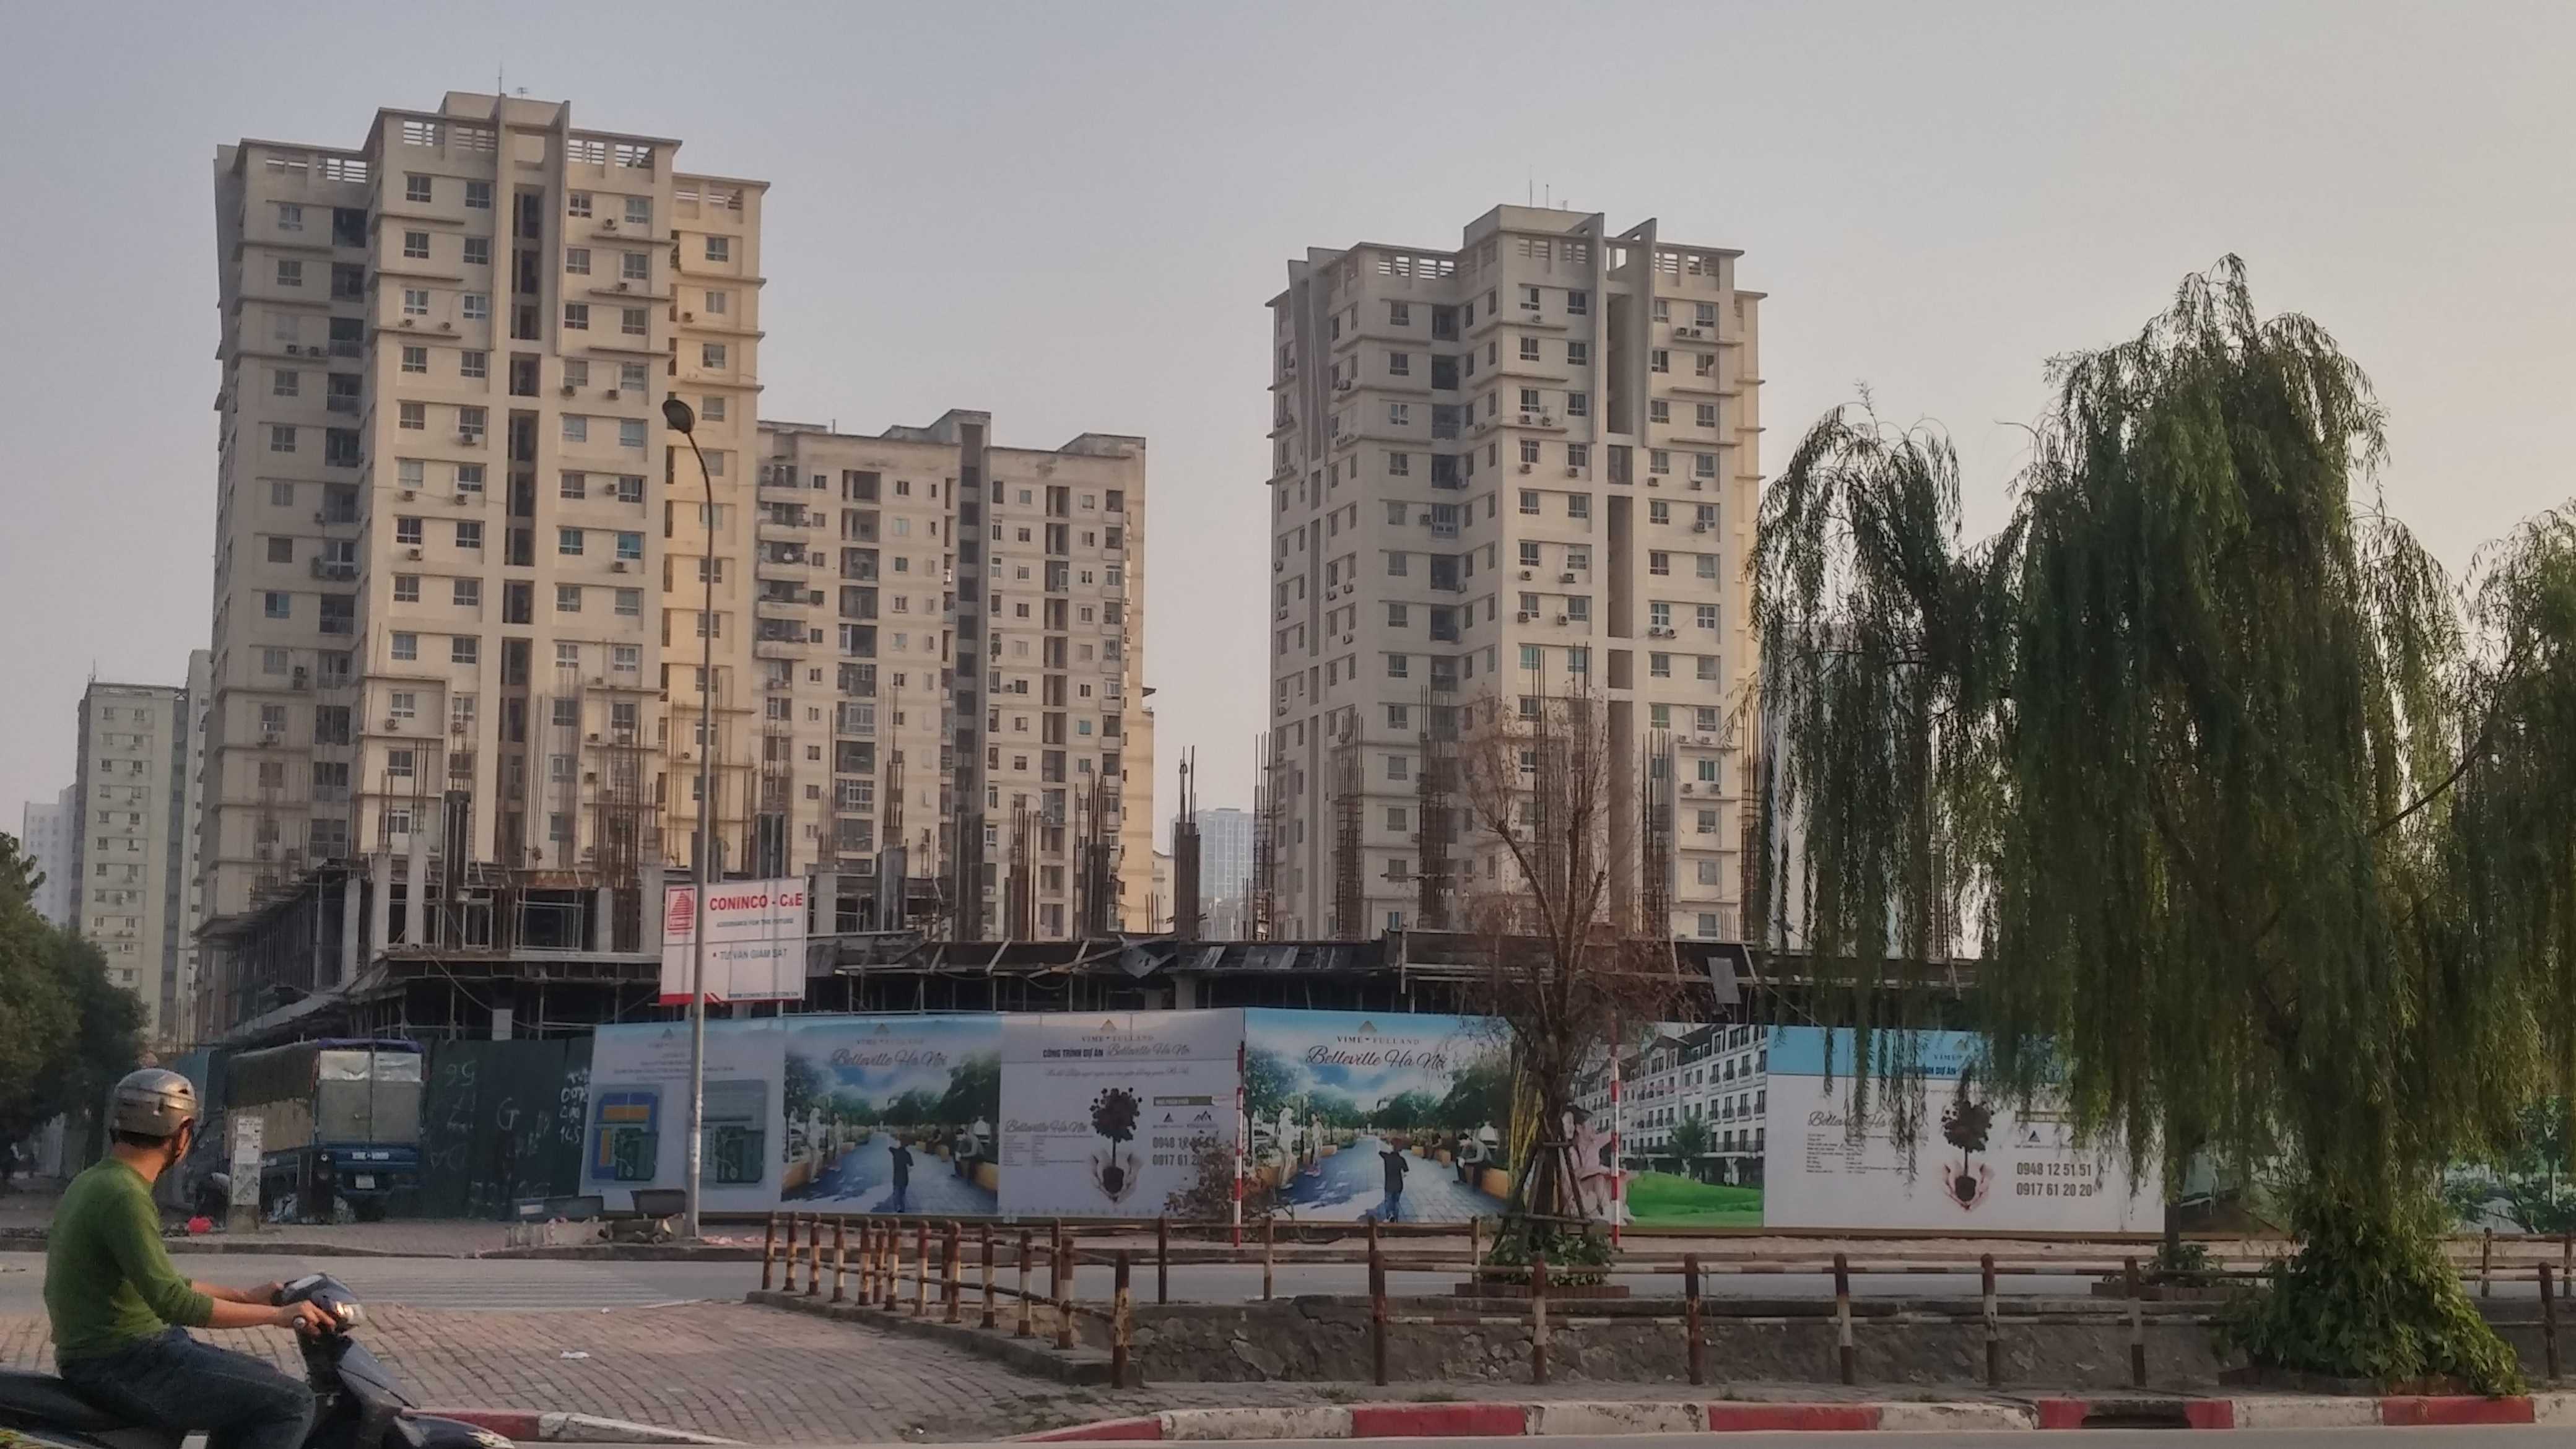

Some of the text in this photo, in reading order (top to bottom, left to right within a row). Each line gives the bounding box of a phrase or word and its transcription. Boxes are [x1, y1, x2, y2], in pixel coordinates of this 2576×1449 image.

[710, 895, 768, 910] CONINCO
[1336, 1035, 1362, 1043] VIME
[1305, 1045, 1381, 1066] Belleville
[2017, 1162, 2091, 1177] 0948 12 51 51
[2016, 1182, 2092, 1197] 0917 61 20 20
